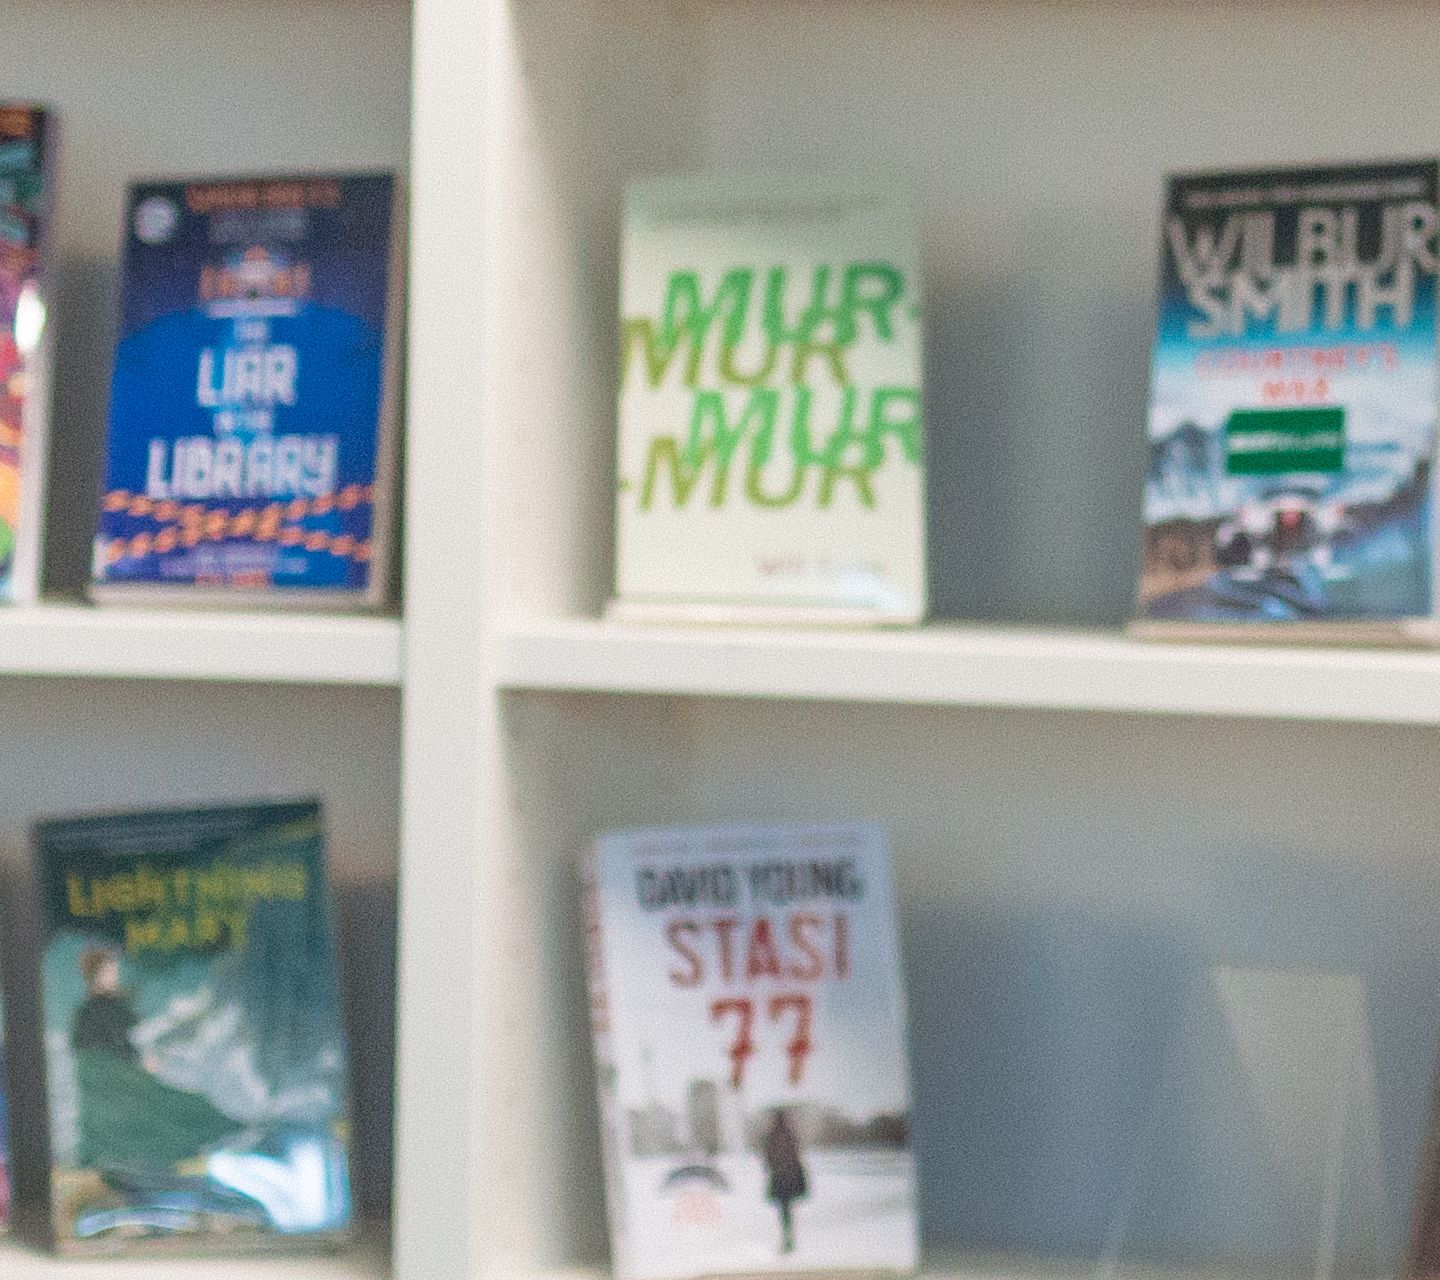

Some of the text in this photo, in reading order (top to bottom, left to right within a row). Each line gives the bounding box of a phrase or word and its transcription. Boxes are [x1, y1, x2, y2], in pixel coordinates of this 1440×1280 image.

[1187, 261, 1416, 338] SMITH
[682, 384, 921, 474] MUR
[634, 856, 864, 912] DAVID YOUNG
[665, 913, 853, 988] STASI
[708, 992, 815, 1091] 77
